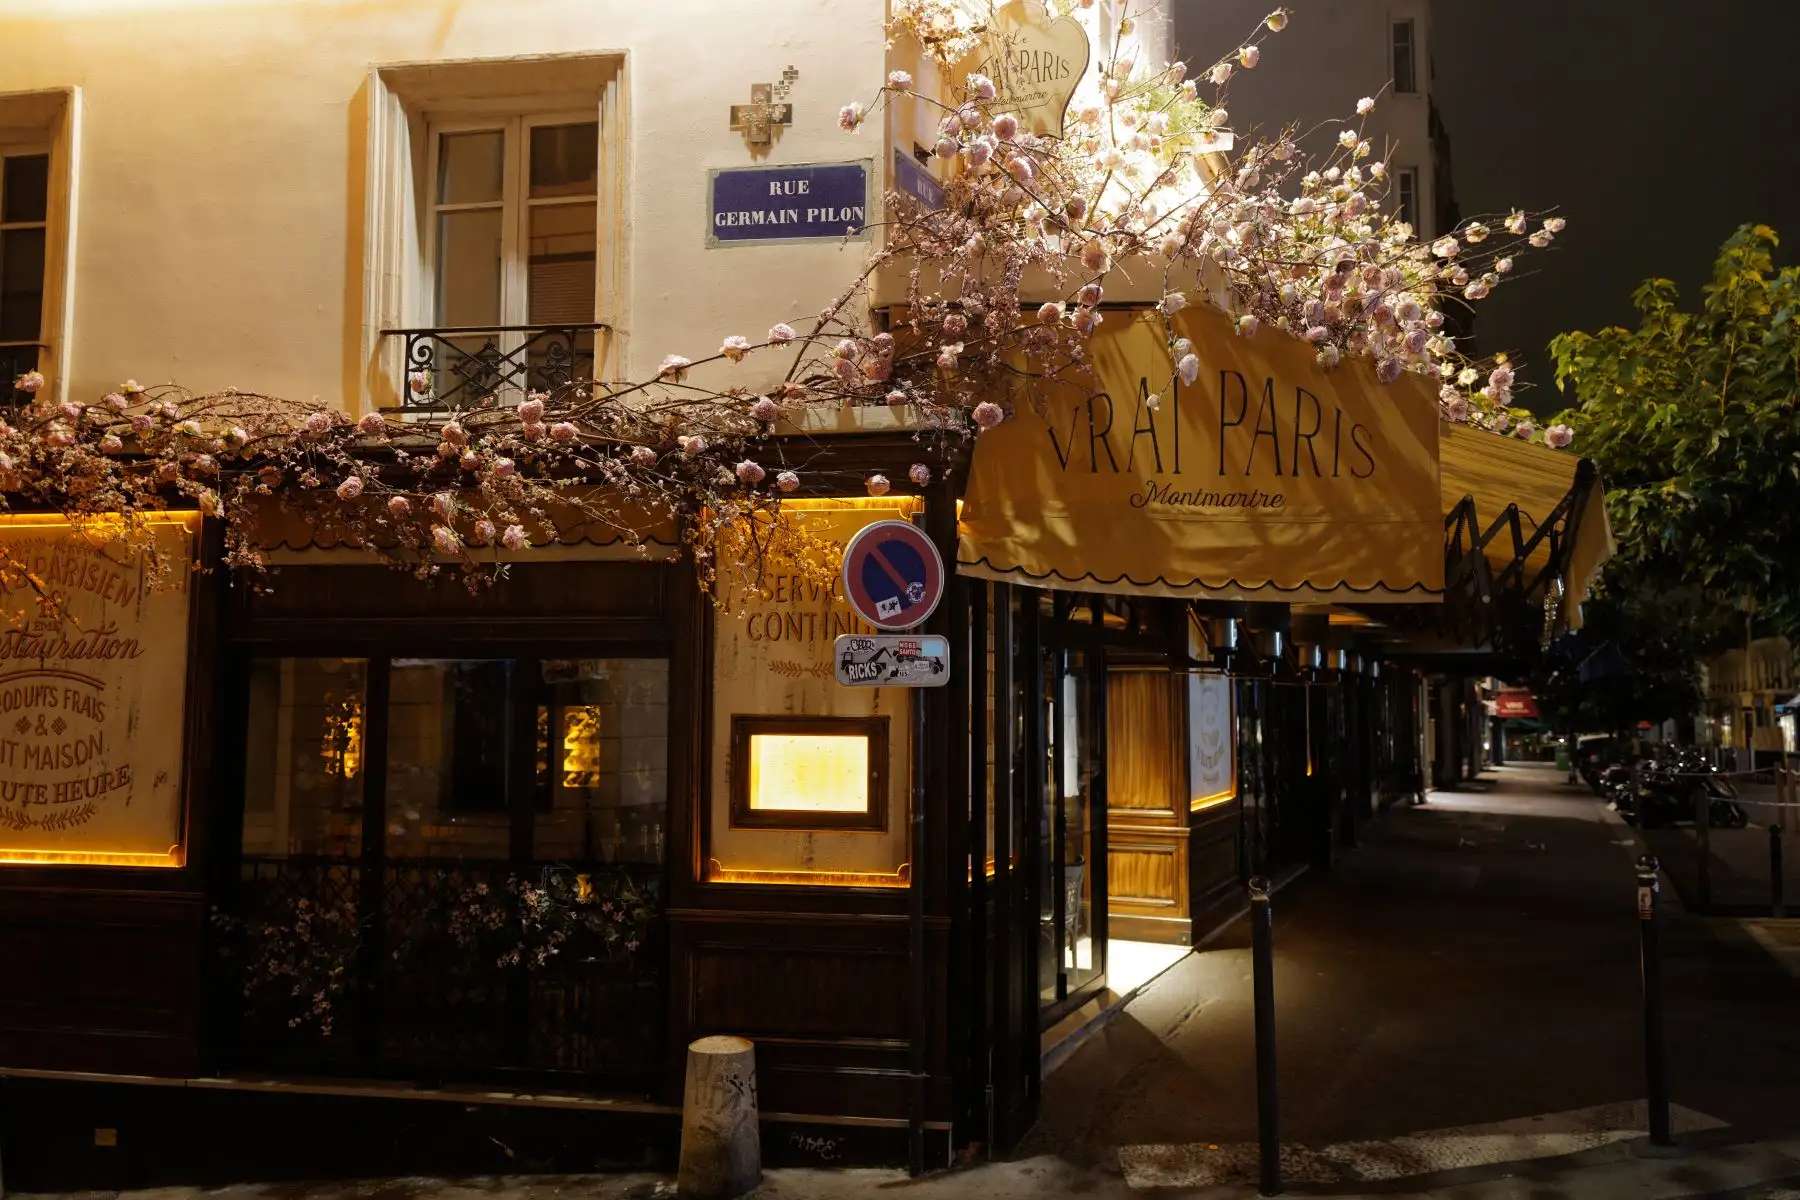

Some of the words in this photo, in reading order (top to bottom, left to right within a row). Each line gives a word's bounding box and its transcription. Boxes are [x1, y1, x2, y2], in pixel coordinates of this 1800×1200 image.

[1020, 49, 1070, 84] PARIS
[769, 180, 809, 196] RUE
[715, 208, 799, 226] GERMAIN
[807, 206, 865, 222] PILON
[1046, 375, 1182, 474] VRAI
[1219, 370, 1375, 478] PARIS
[1129, 480, 1286, 509] Montmartre
[34, 553, 137, 608] PARISIEN
[848, 661, 878, 681] RICKS
[0, 684, 59, 714] ODUITS
[64, 688, 106, 723] FRAIS
[34, 714, 48, 736] &
[23, 729, 103, 771] MAISON
[52, 763, 131, 804] HEURE
